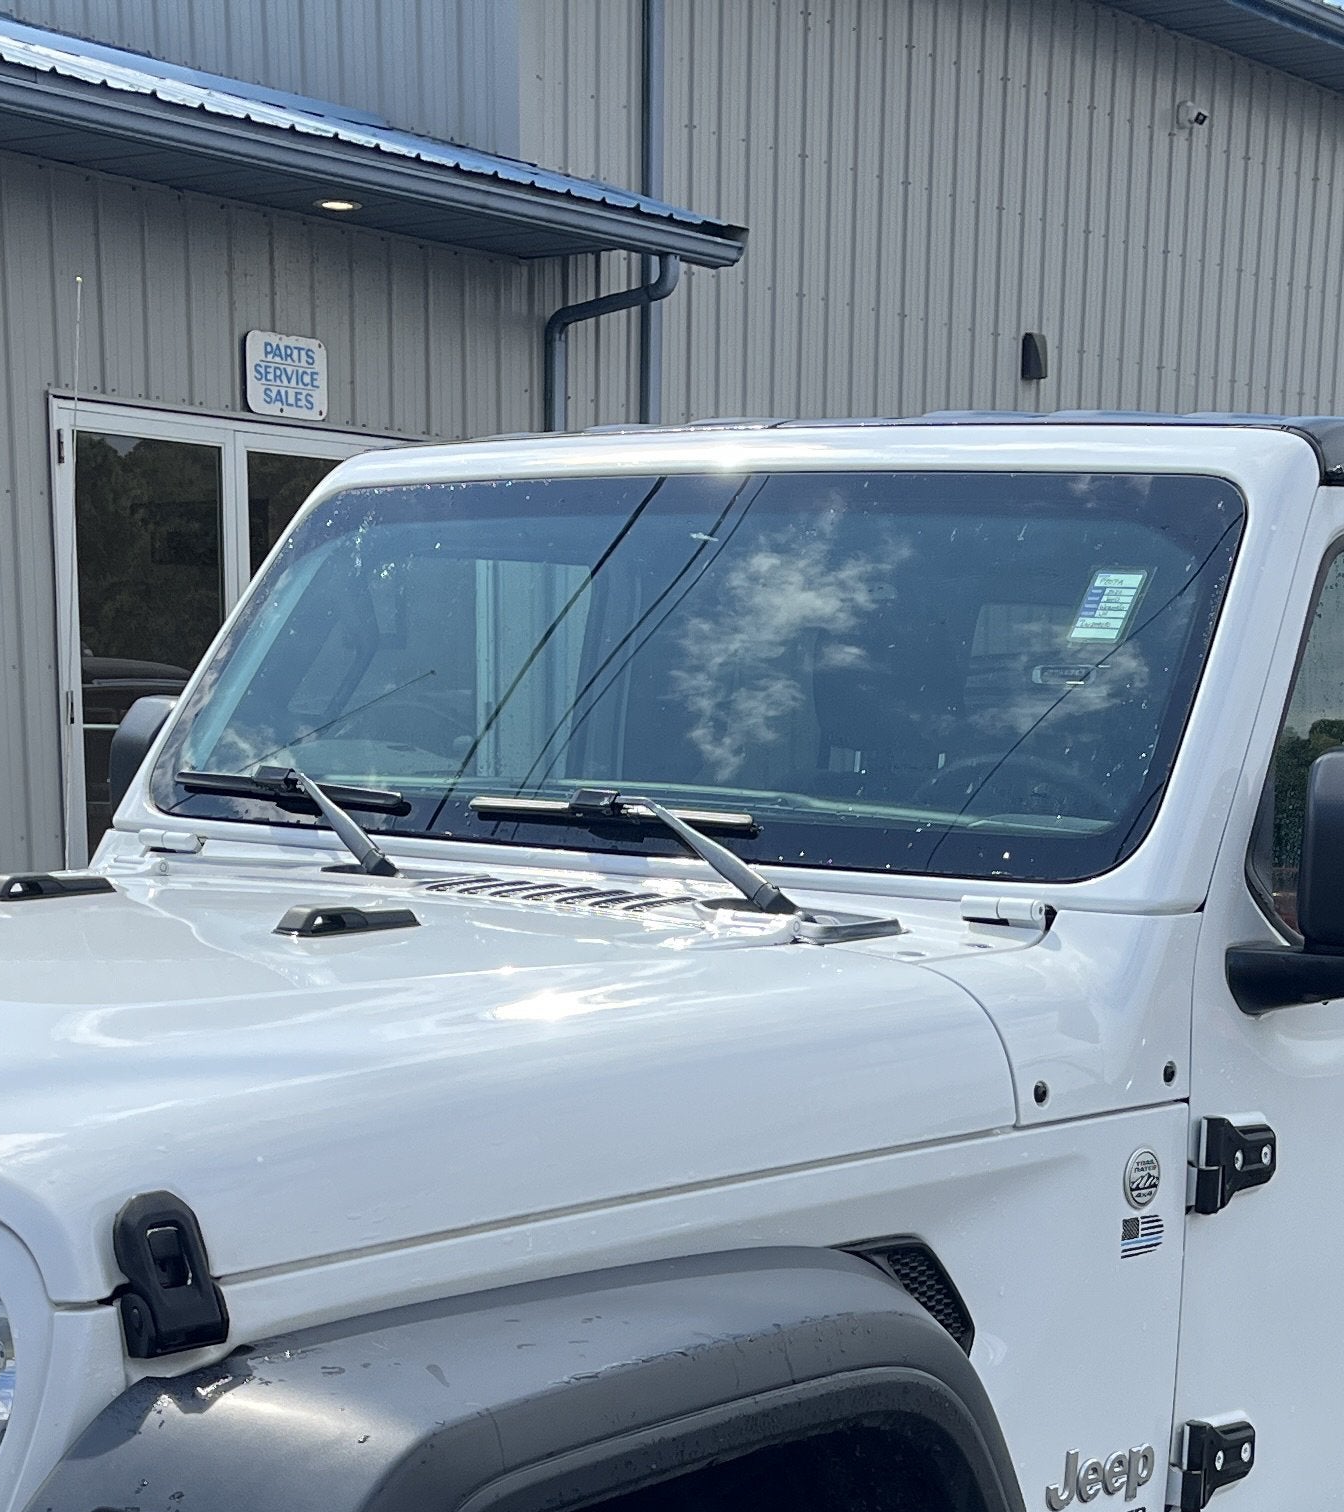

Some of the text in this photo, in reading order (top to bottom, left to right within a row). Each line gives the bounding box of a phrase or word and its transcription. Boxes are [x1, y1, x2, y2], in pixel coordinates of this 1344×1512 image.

[264, 341, 315, 366] PARTS
[254, 363, 320, 389] SERVICE
[264, 388, 313, 410] SALES
[1046, 1443, 1154, 1512] Jeep
